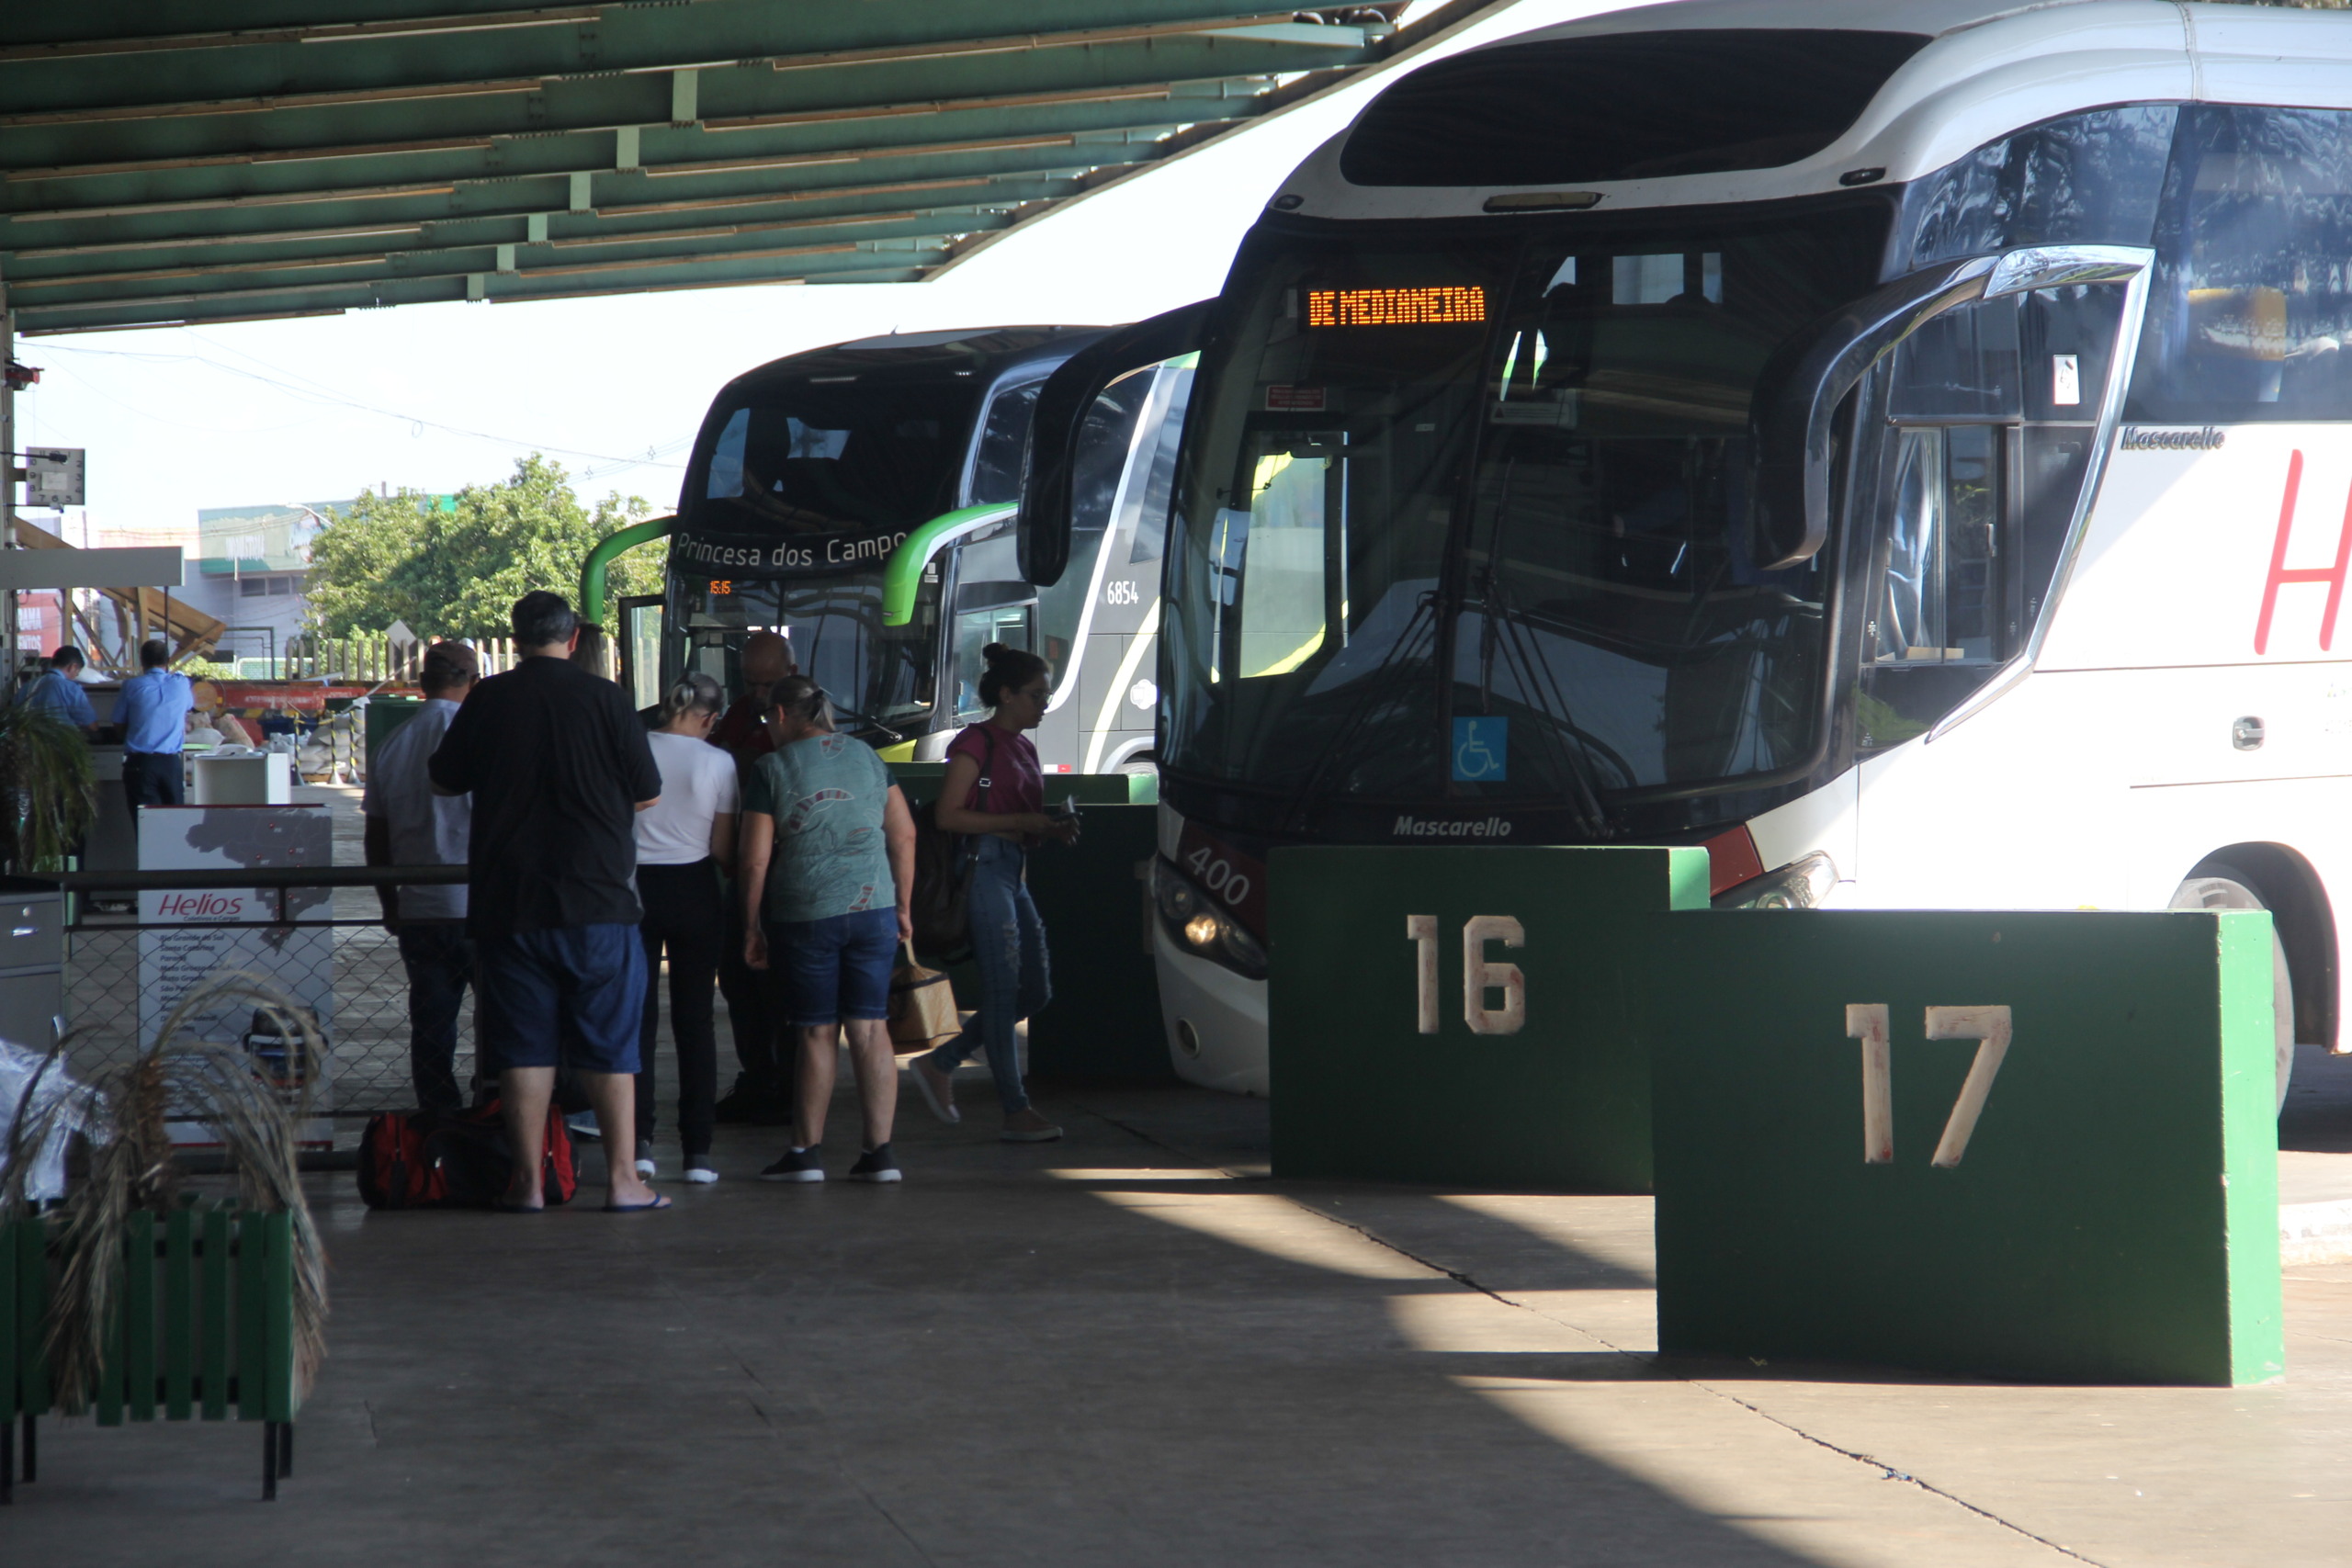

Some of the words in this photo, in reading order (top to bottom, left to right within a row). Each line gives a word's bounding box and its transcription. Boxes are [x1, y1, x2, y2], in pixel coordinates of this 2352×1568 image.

[1310, 291, 1335, 325] DE
[1340, 287, 1485, 324] MEDIANEIRA
[2120, 425, 2226, 450] Mascarello
[676, 533, 761, 566] Princesa
[772, 543, 812, 566] dos
[1107, 580, 1139, 605] 6854
[1393, 816, 1512, 837] Mascarello
[1188, 846, 1250, 906] 400
[158, 893, 243, 916] Helios
[1408, 915, 1525, 1035] 16
[1846, 1003, 2013, 1168] 17
